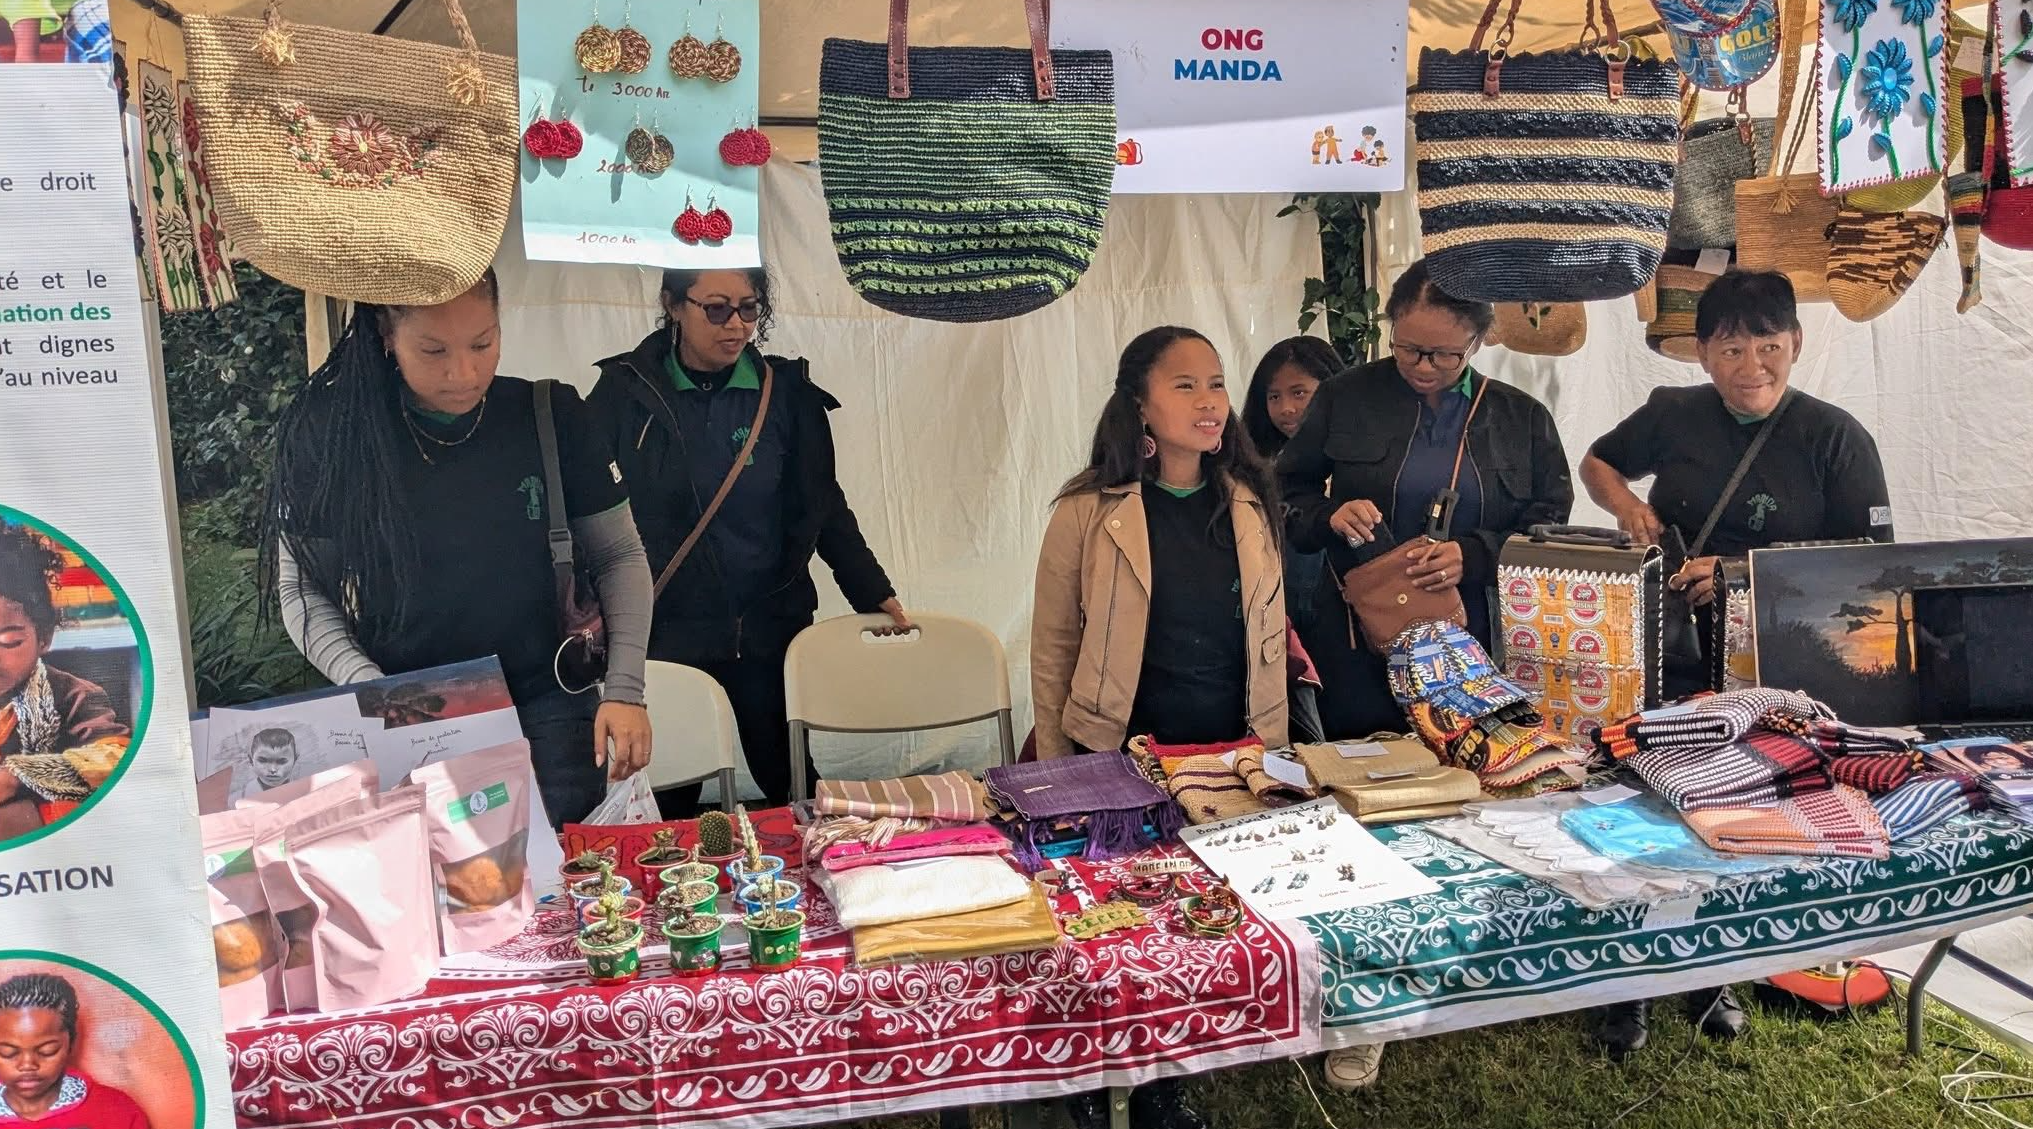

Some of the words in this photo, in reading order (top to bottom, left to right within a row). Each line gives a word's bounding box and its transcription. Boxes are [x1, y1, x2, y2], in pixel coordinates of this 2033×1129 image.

[1201, 28, 1263, 51] ONG
[1174, 59, 1282, 82] MANDA
[612, 82, 653, 98] 3000
[40, 172, 97, 191] droit
[577, 232, 618, 244] 1000
[41, 272, 65, 289] et
[86, 269, 107, 288] le
[0, 303, 63, 323] ation
[70, 302, 111, 320] des
[0, 338, 13, 355] t
[39, 335, 115, 357] dignes
[41, 366, 118, 385] niveau
